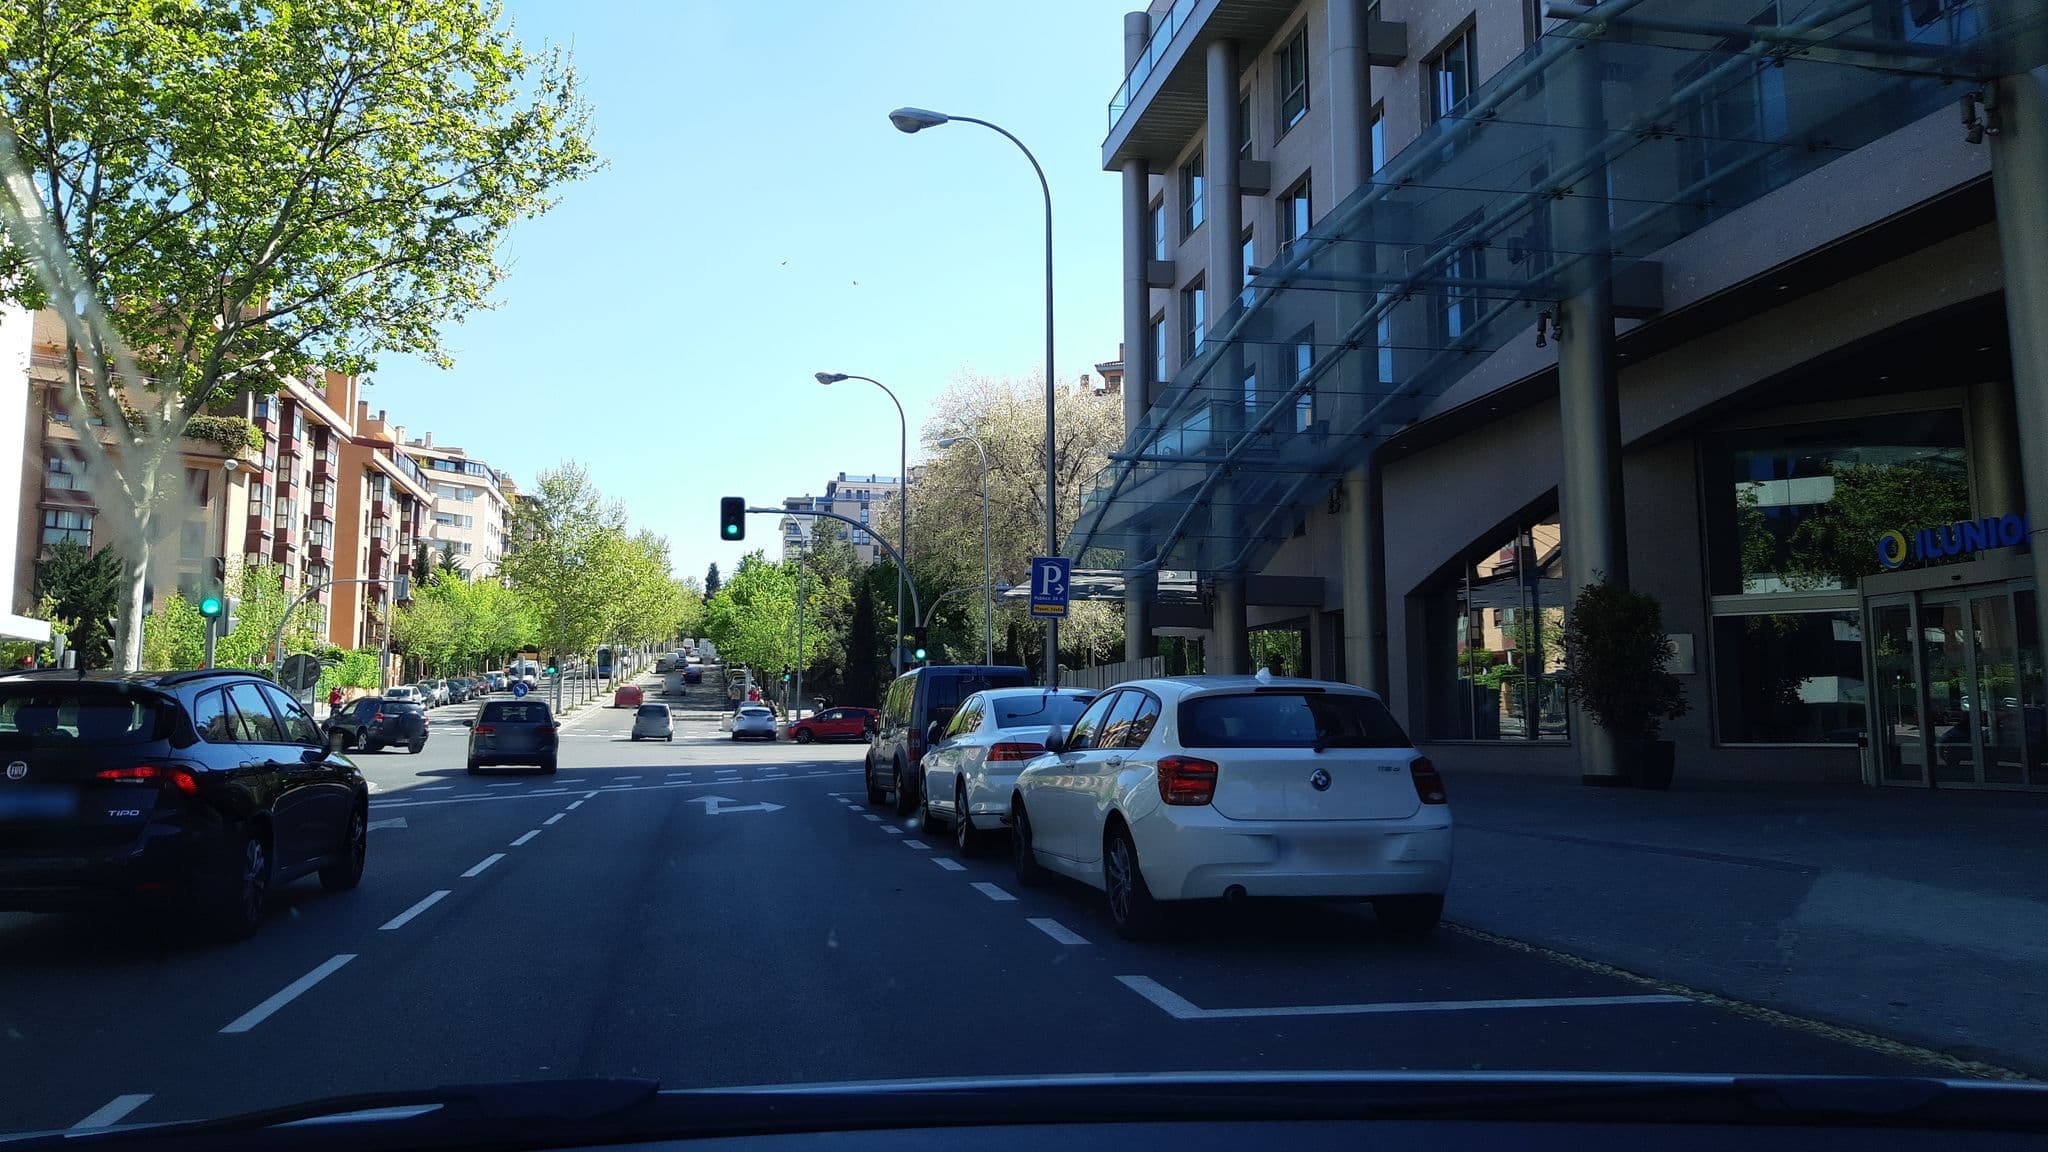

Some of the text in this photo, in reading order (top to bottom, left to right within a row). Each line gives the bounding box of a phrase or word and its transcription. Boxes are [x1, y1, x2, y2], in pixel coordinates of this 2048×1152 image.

[1040, 565, 1062, 595] P
[11, 765, 24, 776] FIAT
[107, 809, 140, 817] TIPO
